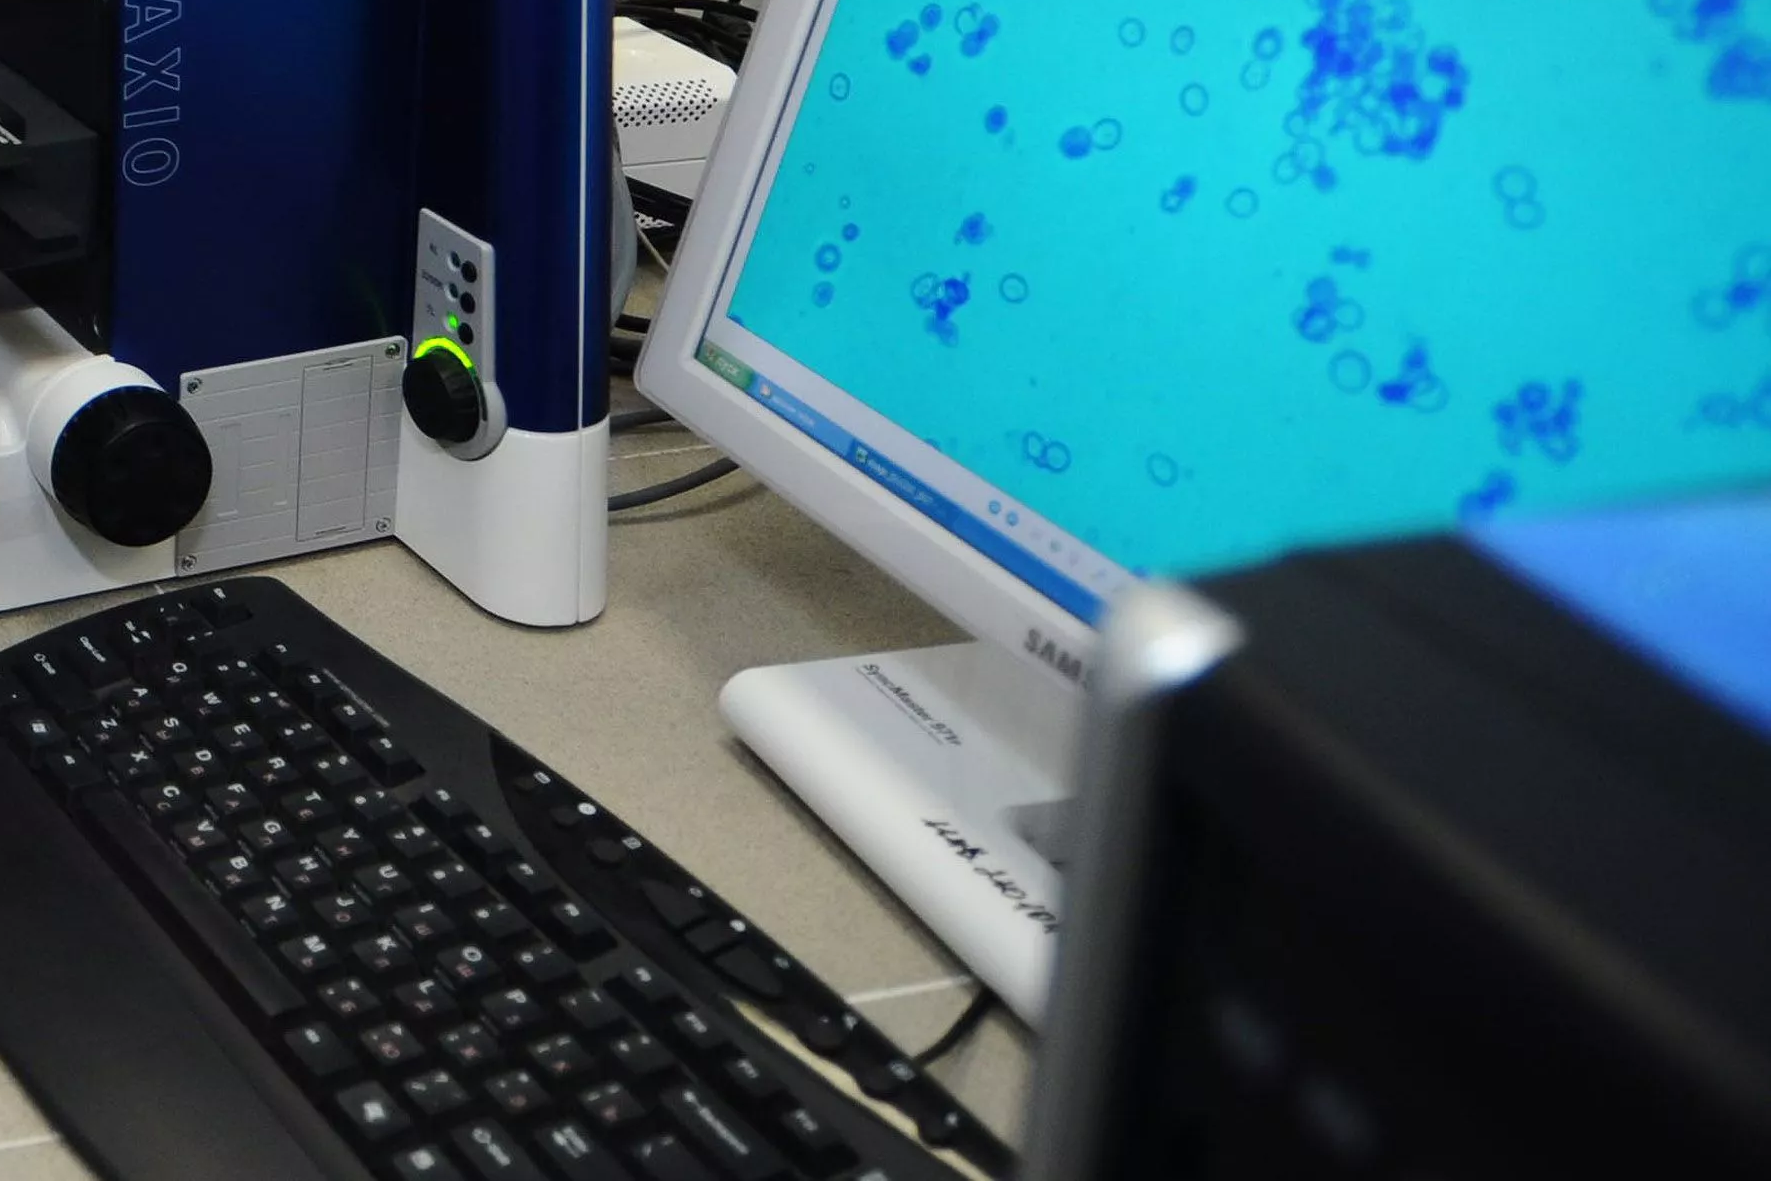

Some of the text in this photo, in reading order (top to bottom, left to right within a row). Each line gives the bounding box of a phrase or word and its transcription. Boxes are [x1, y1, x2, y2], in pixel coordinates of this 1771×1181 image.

[863, 662, 934, 722] SyncMaster
[100, 718, 326, 953] Z X C V B N M
[132, 688, 435, 995] A S D F G H J K L
[172, 662, 527, 1004] Q W E R T Y U I O P
